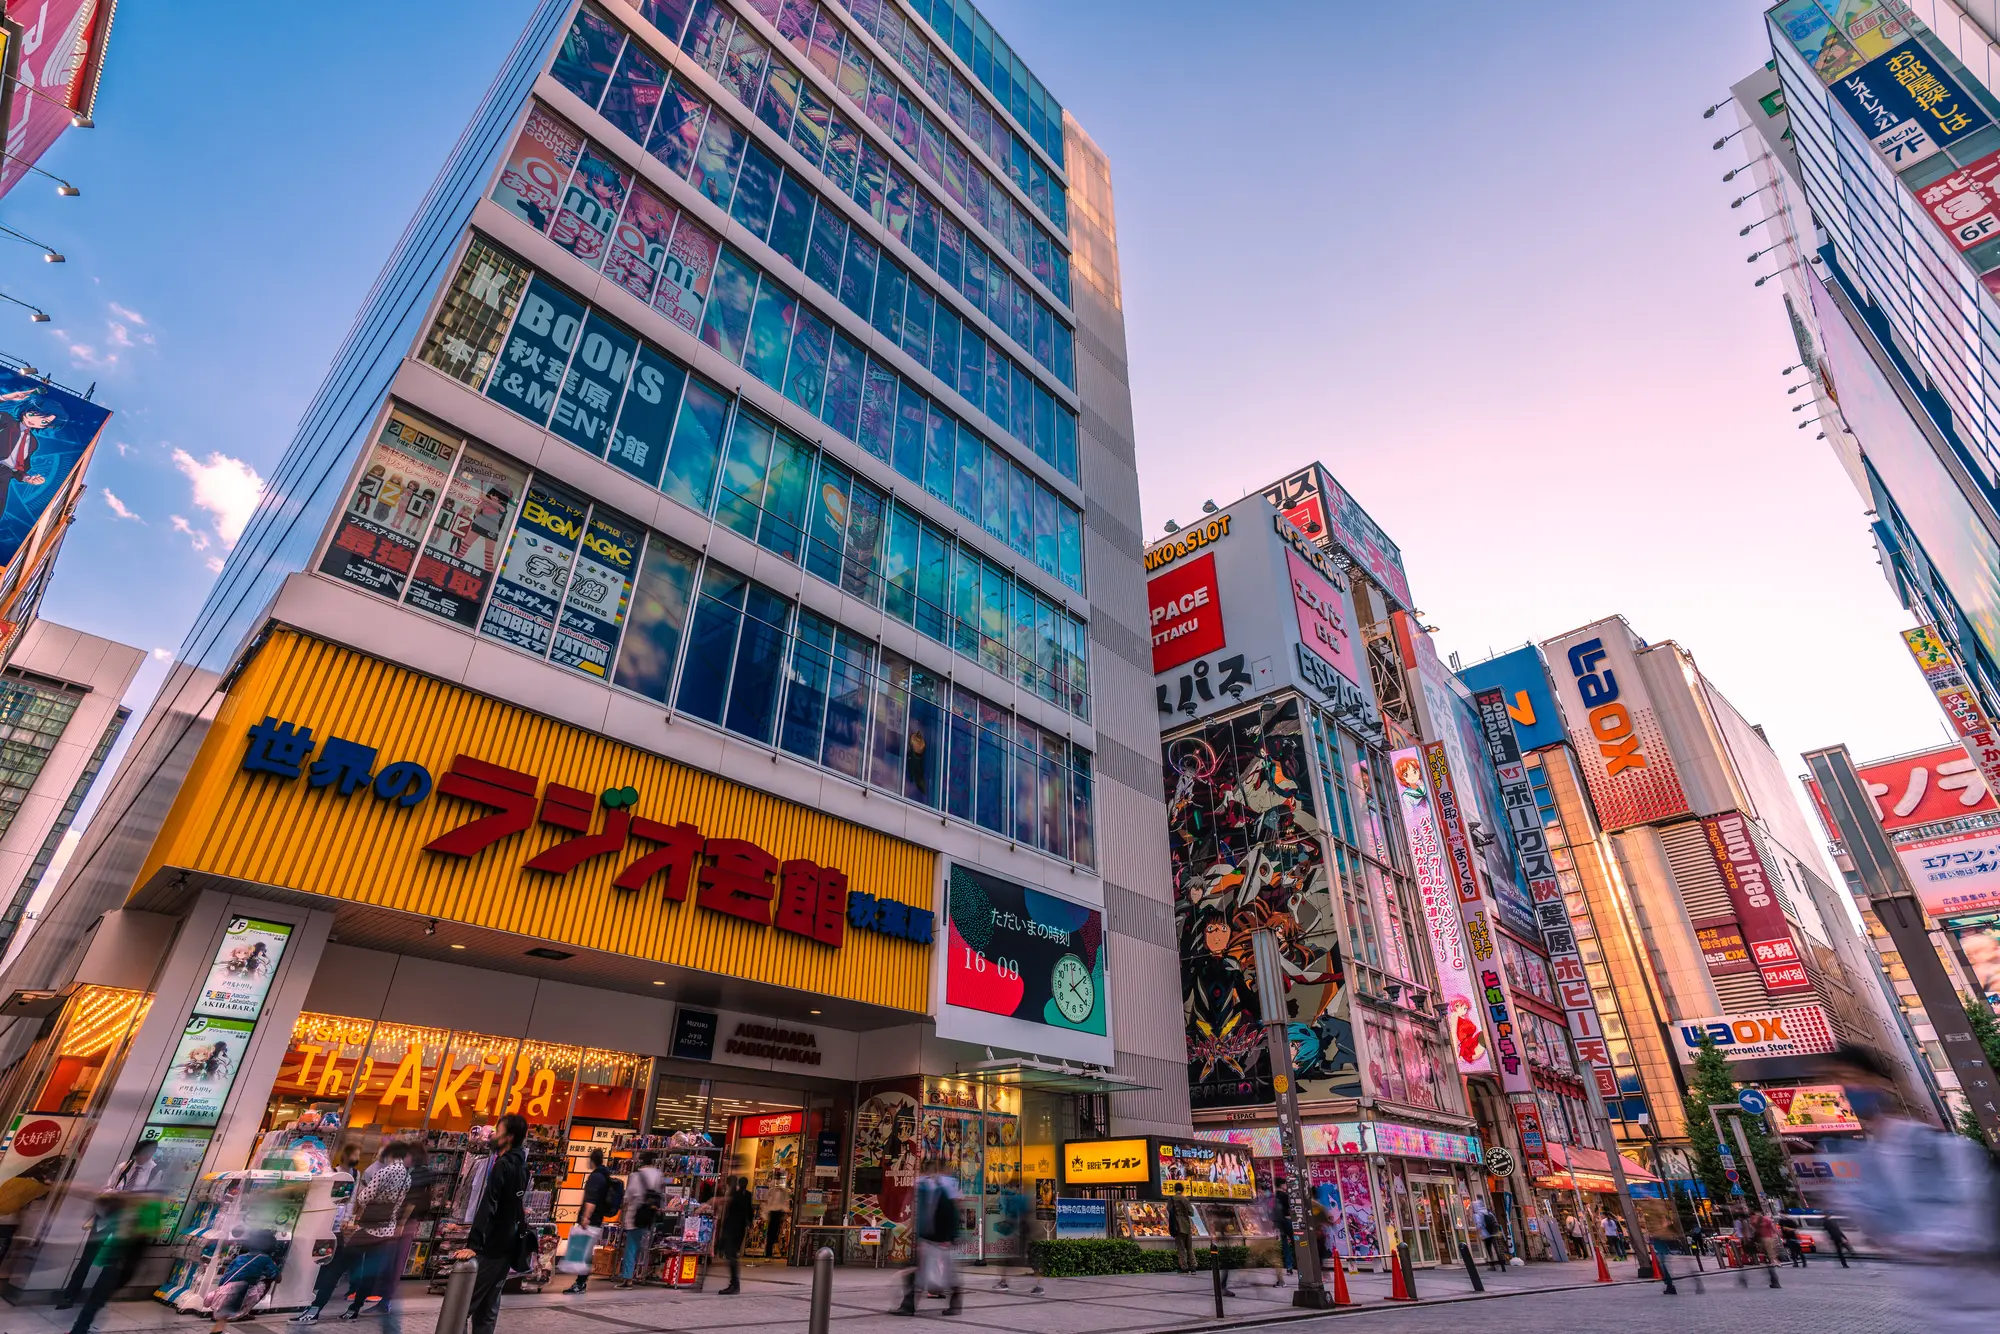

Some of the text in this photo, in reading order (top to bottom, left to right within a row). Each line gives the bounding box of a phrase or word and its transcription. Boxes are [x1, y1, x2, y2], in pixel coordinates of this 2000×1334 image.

[1845, 76, 1899, 132] レオパレス21
[1886, 51, 1972, 135] お部屋探しは
[524, 126, 571, 164] GOODS
[527, 119, 573, 155] ANIME
[531, 111, 577, 147] FIGURES
[1879, 126, 1918, 149] 当ビル
[1885, 133, 1926, 162] 7F
[1960, 216, 1995, 241] 6F
[509, 336, 613, 413] 秋葉原
[523, 500, 632, 567] BIGMAGIC
[344, 569, 381, 588] ジャングル
[518, 573, 547, 592] TOYS
[567, 594, 608, 618] FIGURES
[1294, 577, 1349, 638] エスパス
[592, 639, 610, 652] Shop
[1477, 694, 1507, 763] PARADISE
[1491, 691, 1512, 737] HOBBY
[1436, 749, 1448, 775] DVD
[1439, 791, 1458, 830] 買取り
[243, 716, 935, 949] 世界の ラジオ会館 秋葉原
[1504, 784, 1552, 878] ボークス
[1706, 821, 1739, 890] Flagship Store
[1718, 811, 1771, 909] Duty Free
[1530, 878, 1575, 953] 秋葉原
[1942, 893, 1987, 905] 広告募集中
[991, 907, 1070, 947] ただいまの時刻
[1468, 922, 1484, 961] 買います
[1475, 911, 1493, 958] フィギュア
[964, 947, 1019, 981] 16 09
[1756, 942, 1794, 960] 免税
[1765, 968, 1804, 984] 면세점
[202, 1001, 256, 1012] AKIHABARA
[725, 1038, 822, 1066] RADIOKAIKAN
[735, 1022, 817, 1048] AKIHABARA
[1767, 1043, 1794, 1053] Store
[295, 1044, 374, 1096] The
[156, 1107, 215, 1118] AKIHABARA
[1771, 1091, 1792, 1099] 止まれ
[1233, 1112, 1257, 1120] ESPACE
[16, 1127, 62, 1148] 大好評!
[145, 1129, 160, 1140] 8F
[1086, 1157, 1142, 1171] 銀座ライオン
[1311, 1169, 1336, 1178] SLOT
